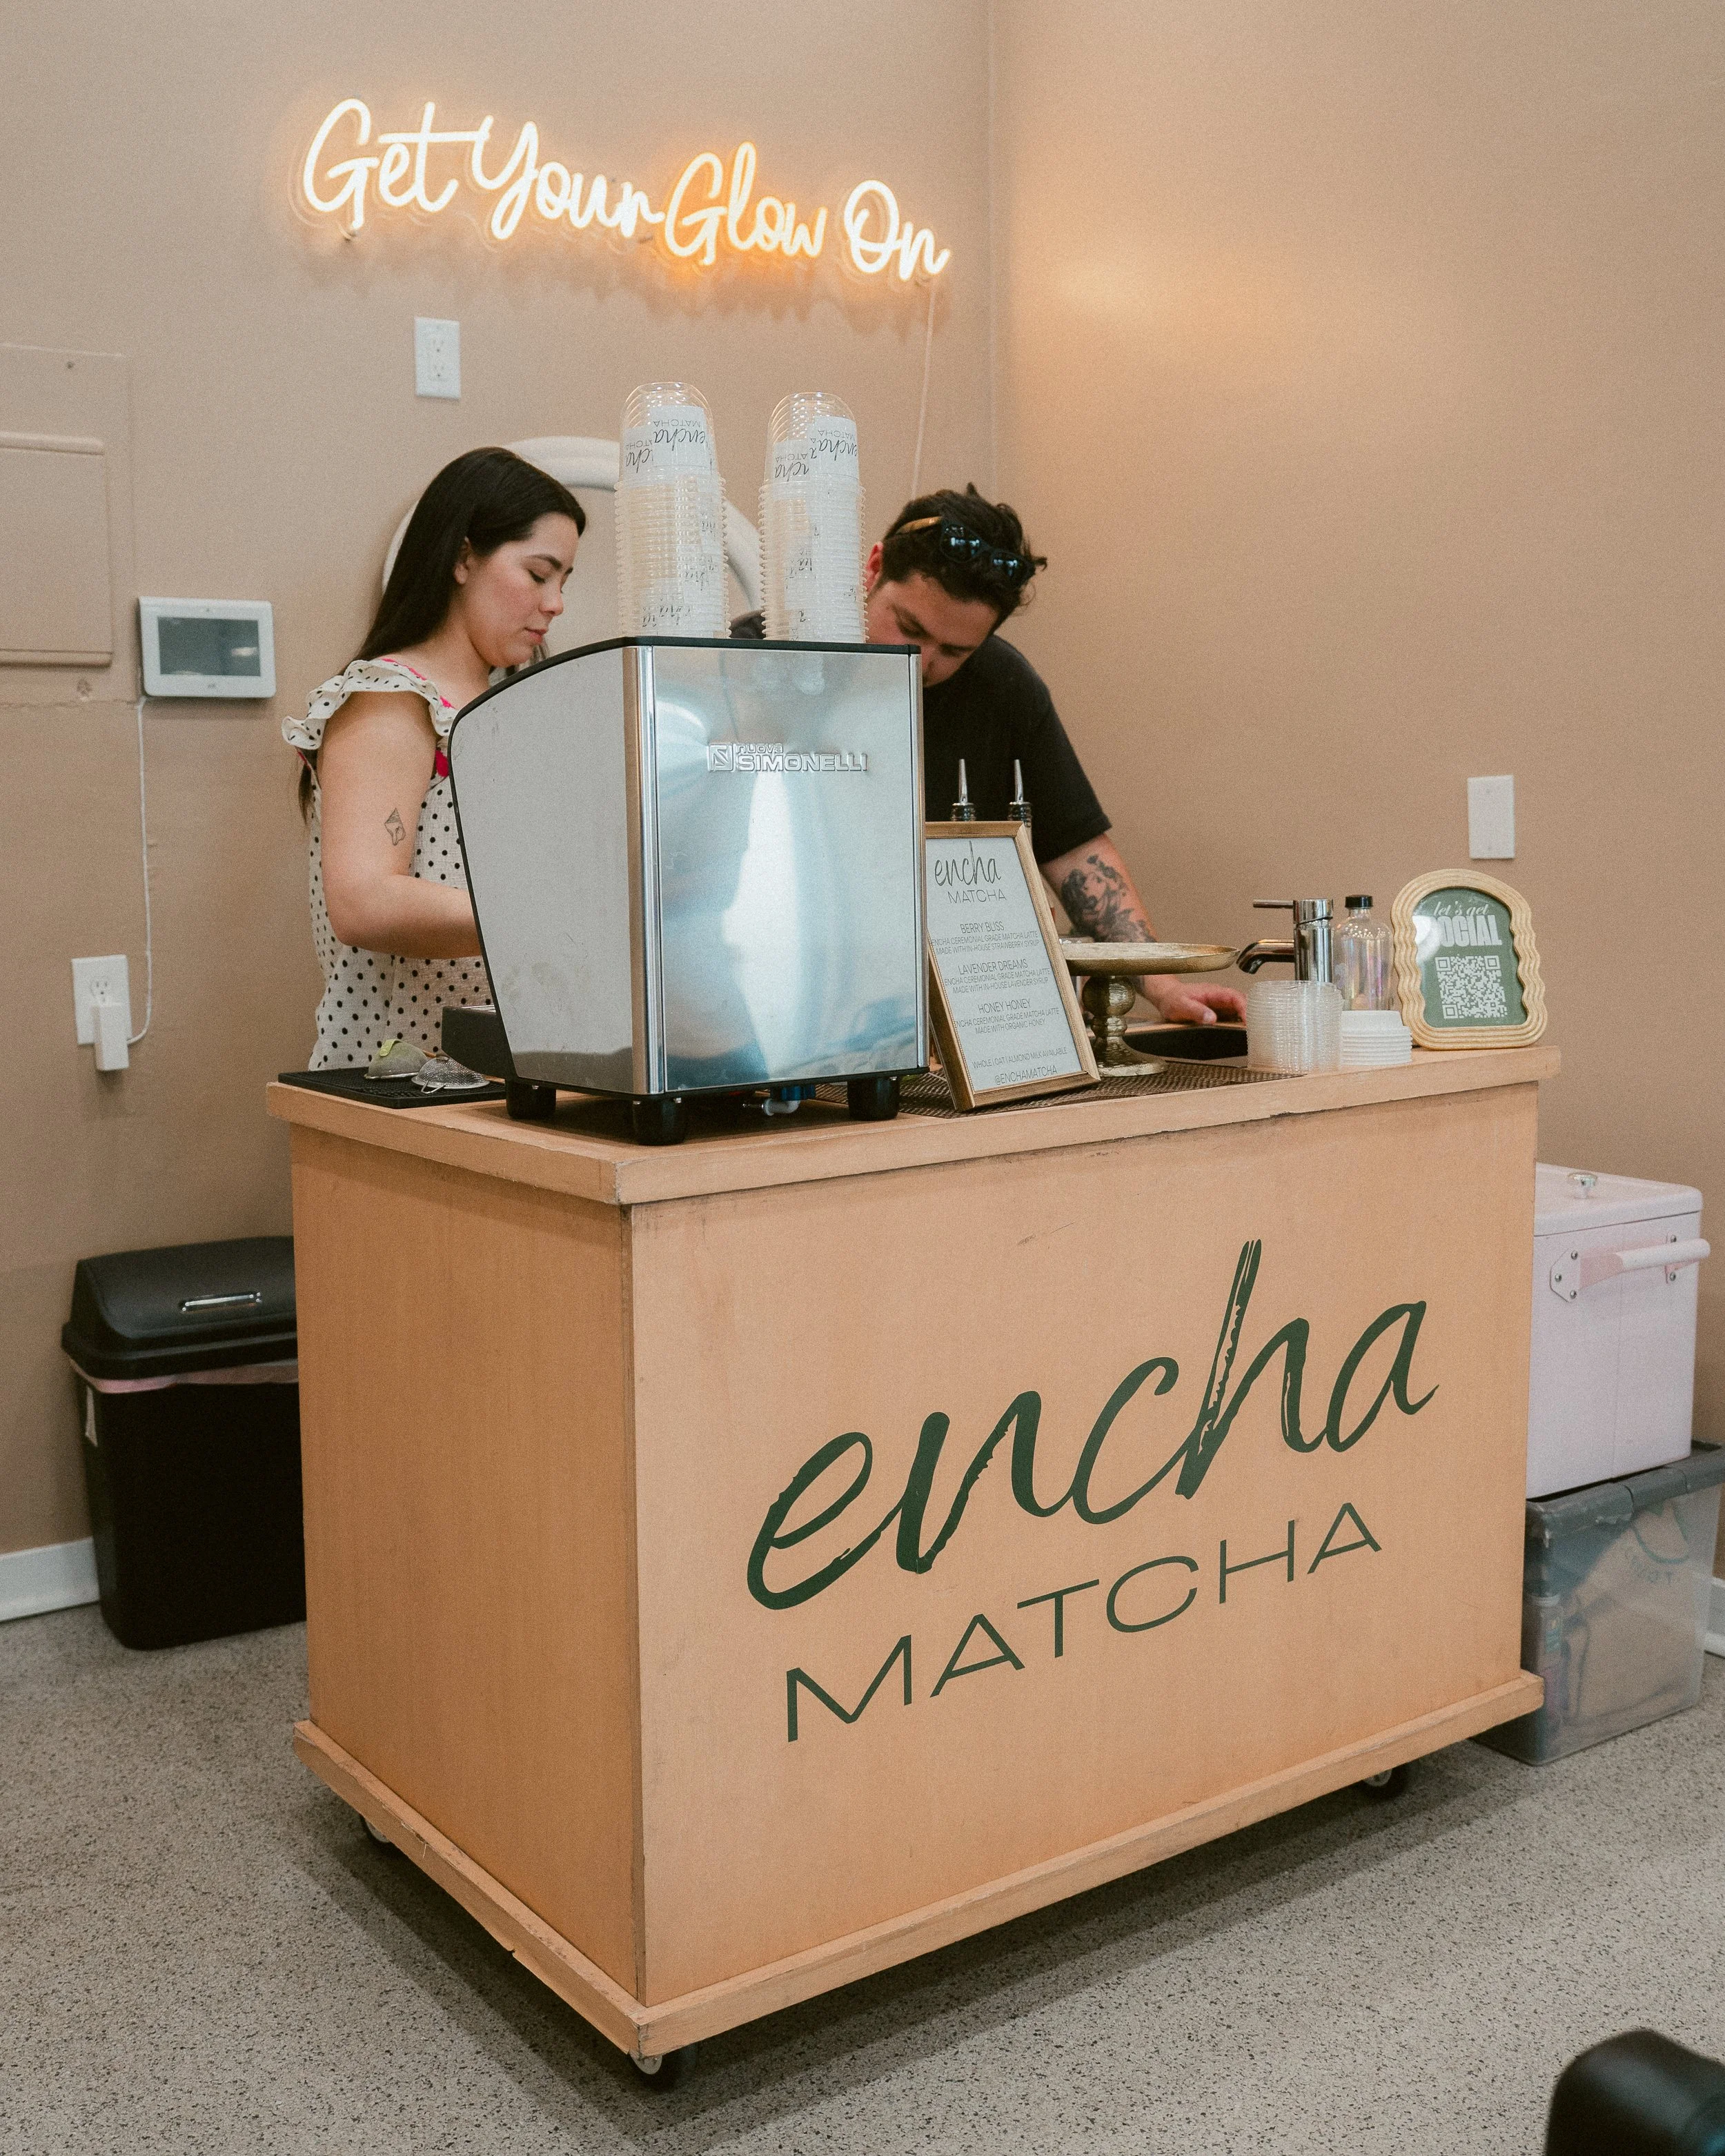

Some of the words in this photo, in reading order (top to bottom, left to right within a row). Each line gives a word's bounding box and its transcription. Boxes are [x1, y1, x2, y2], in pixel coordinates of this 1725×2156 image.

[302, 98, 473, 230] Get
[472, 115, 664, 239] Your
[663, 141, 827, 265] Glow
[843, 179, 952, 281] On
[653, 419, 701, 427] MATCHA
[653, 428, 706, 451] encha
[736, 743, 784, 754] nuova
[736, 753, 867, 772] SIMONELLI
[934, 840, 1002, 887] encha
[947, 889, 1007, 904] MATCHA
[1433, 900, 1463, 916] let's
[1466, 903, 1489, 916] get
[960, 922, 983, 934] BERRY
[985, 921, 1005, 932] BLISS
[951, 935, 984, 945] CEREMONIAL
[985, 933, 1001, 942] GRADE
[1002, 932, 1023, 940] MATCHA
[1024, 931, 1038, 939] LATTE
[953, 945, 966, 953] WITH
[967, 943, 991, 952] IN-HOUSE
[992, 941, 1024, 950] STRAWBERRY
[1024, 939, 1040, 947] SYRUP
[958, 961, 998, 975] LAVENDER
[998, 958, 1028, 971] DREAMS
[945, 978, 963, 986] ENCHA
[964, 973, 997, 984] CEREMONIAL
[998, 971, 1014, 980] GRADE
[1014, 970, 1036, 978] MATCHA
[1036, 968, 1051, 976] LATTE
[983, 981, 1007, 991] IN-HOUSE
[1007, 978, 1033, 988] LAVENDER
[1033, 976, 1049, 985] SYRUP
[978, 1001, 1004, 1014] HONEY
[1006, 998, 1031, 1010] HONEY
[973, 1015, 1006, 1026] CEREMONIAL
[1006, 1012, 1023, 1020] GRADE
[1024, 1009, 1045, 1018] MATCHA
[1045, 1007, 1060, 1016] LATTE
[1005, 1020, 1029, 1030] ORGANIC
[1029, 1018, 1046, 1027] HONEY
[972, 1059, 992, 1069] WHOLE
[995, 1056, 1005, 1065] OAT
[1008, 1054, 1030, 1063] ALMOND
[1030, 1051, 1043, 1060] MILK
[1043, 1047, 1068, 1057] AVAILABLE
[994, 1065, 1058, 1085] @ENCHAMATCHA
[747, 1238, 1440, 1610] encha
[785, 1501, 1383, 1742] MATCHA
